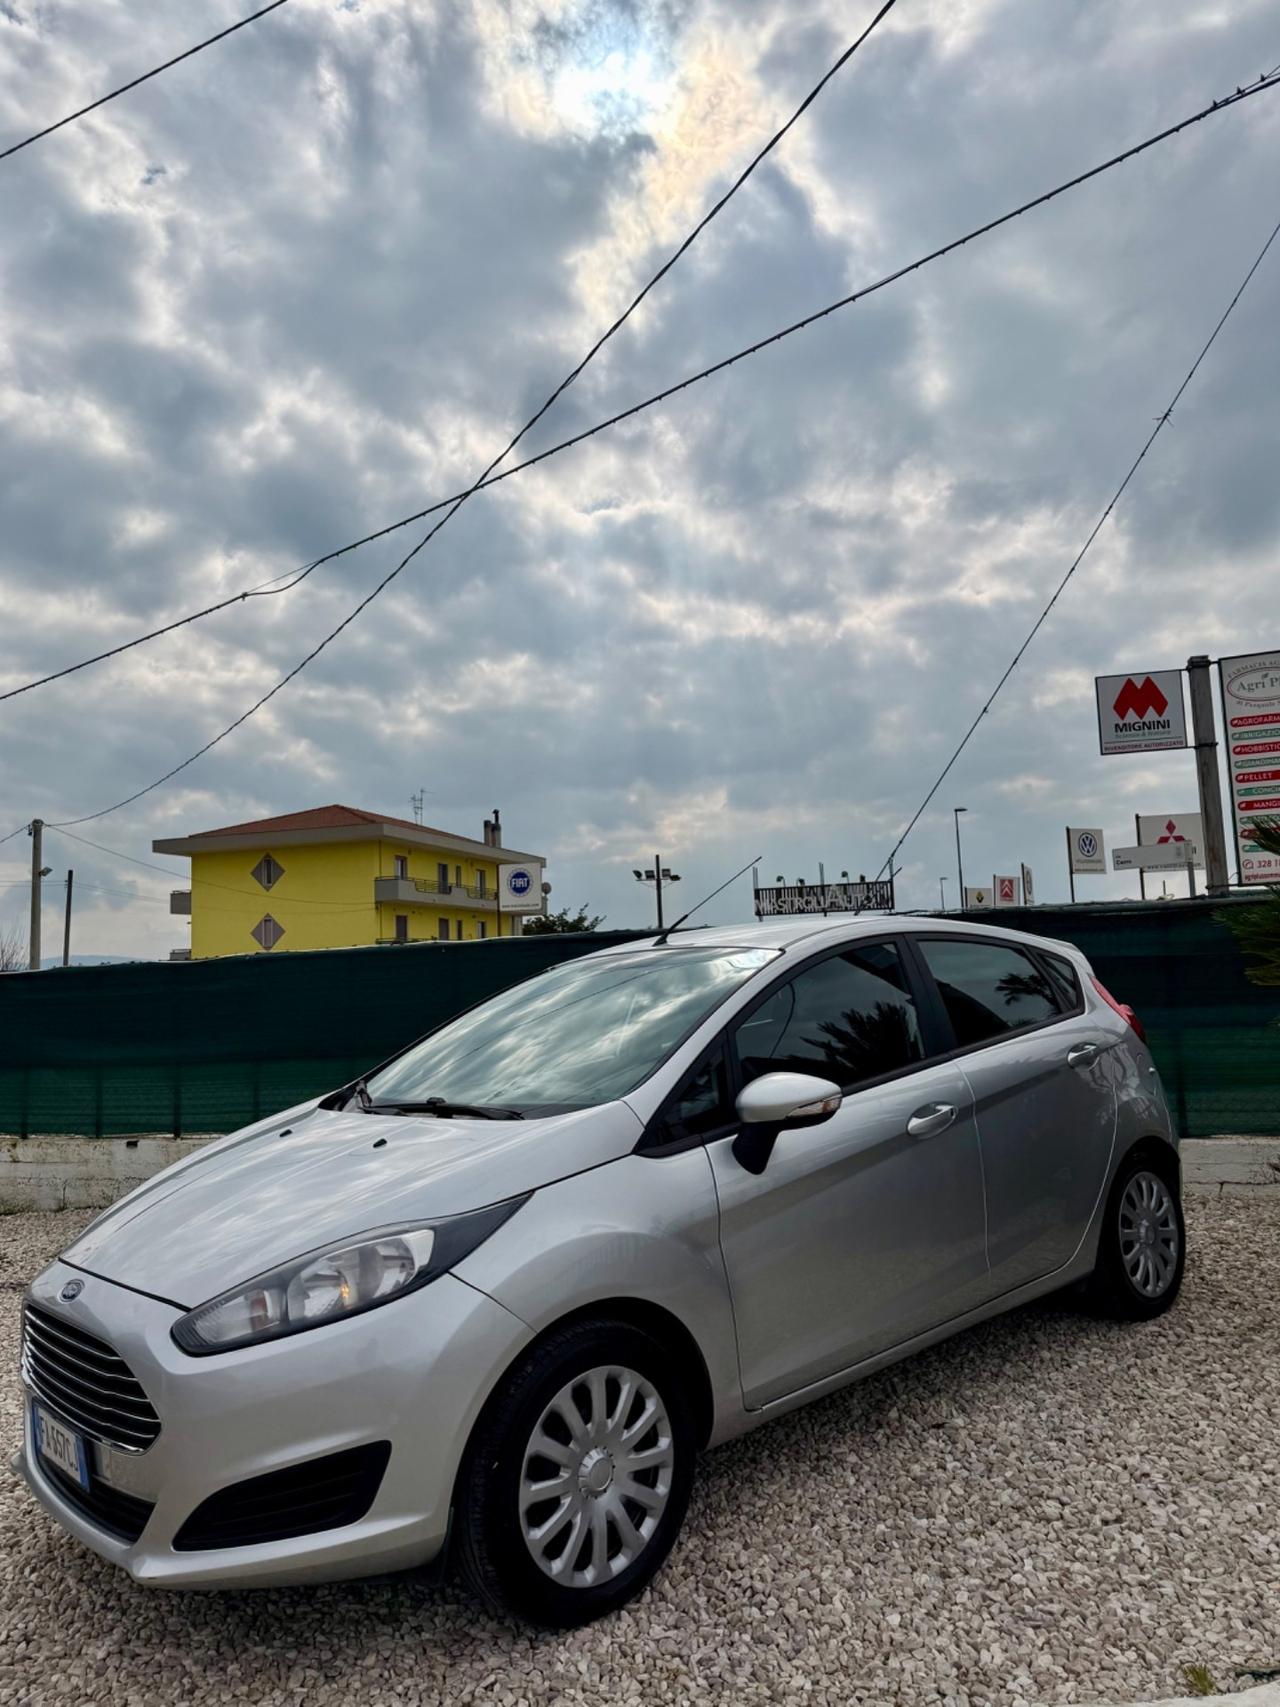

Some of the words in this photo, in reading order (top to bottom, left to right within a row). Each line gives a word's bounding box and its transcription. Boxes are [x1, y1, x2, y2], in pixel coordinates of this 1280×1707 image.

[1237, 681, 1266, 693] Agri
[1114, 719, 1171, 733] MIGNINI
[1104, 744, 1142, 752] RIVENDITORE
[1144, 740, 1184, 748] AUTORIZZATO
[1244, 772, 1272, 781] PELLET
[1257, 859, 1272, 868] 328
[511, 877, 528, 888] FIAT
